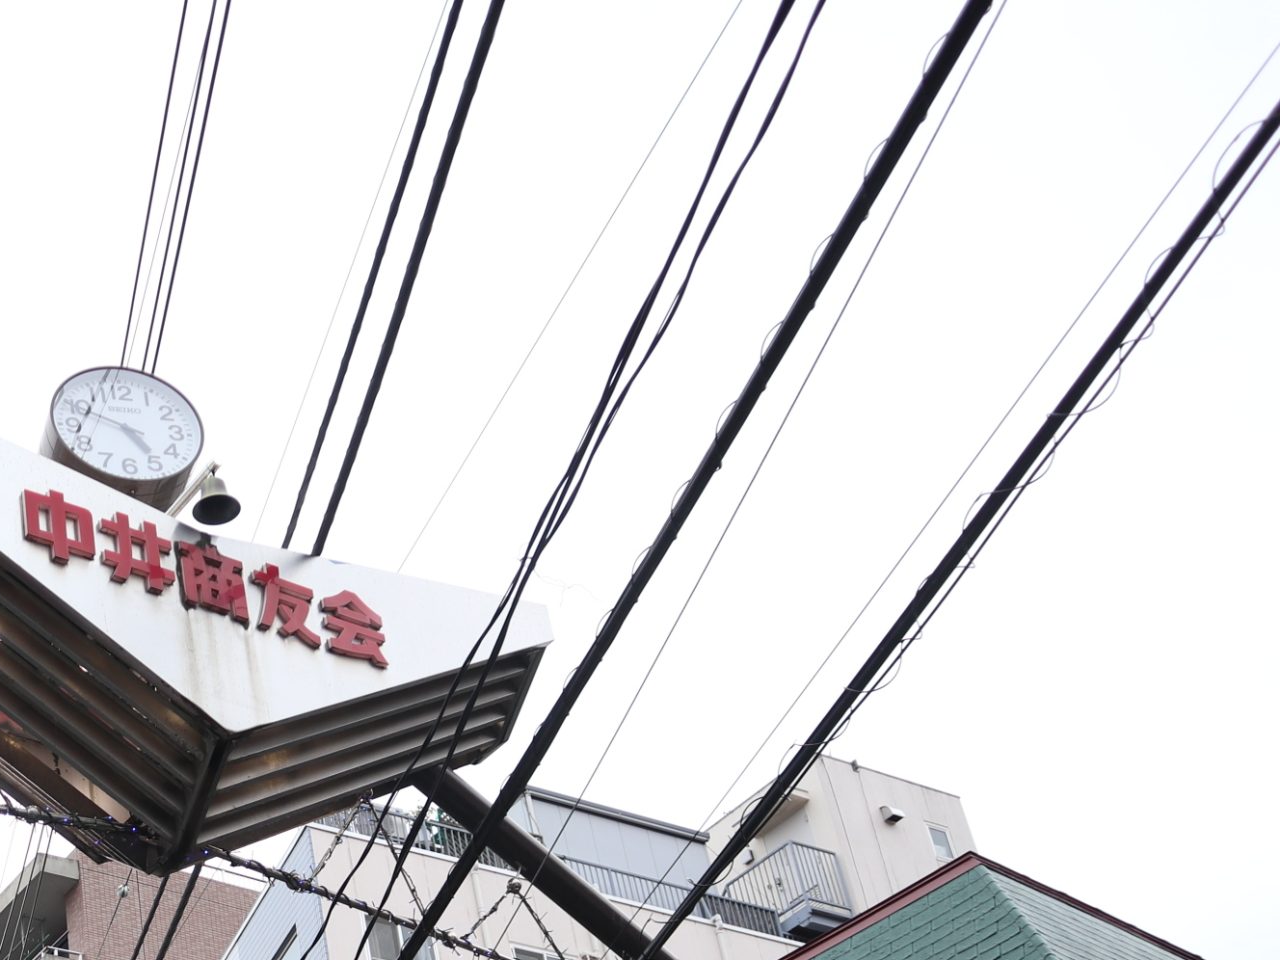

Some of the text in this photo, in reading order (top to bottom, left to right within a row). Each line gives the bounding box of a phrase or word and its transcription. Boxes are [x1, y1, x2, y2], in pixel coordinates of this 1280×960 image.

[21, 488, 389, 669] 中井商友会
